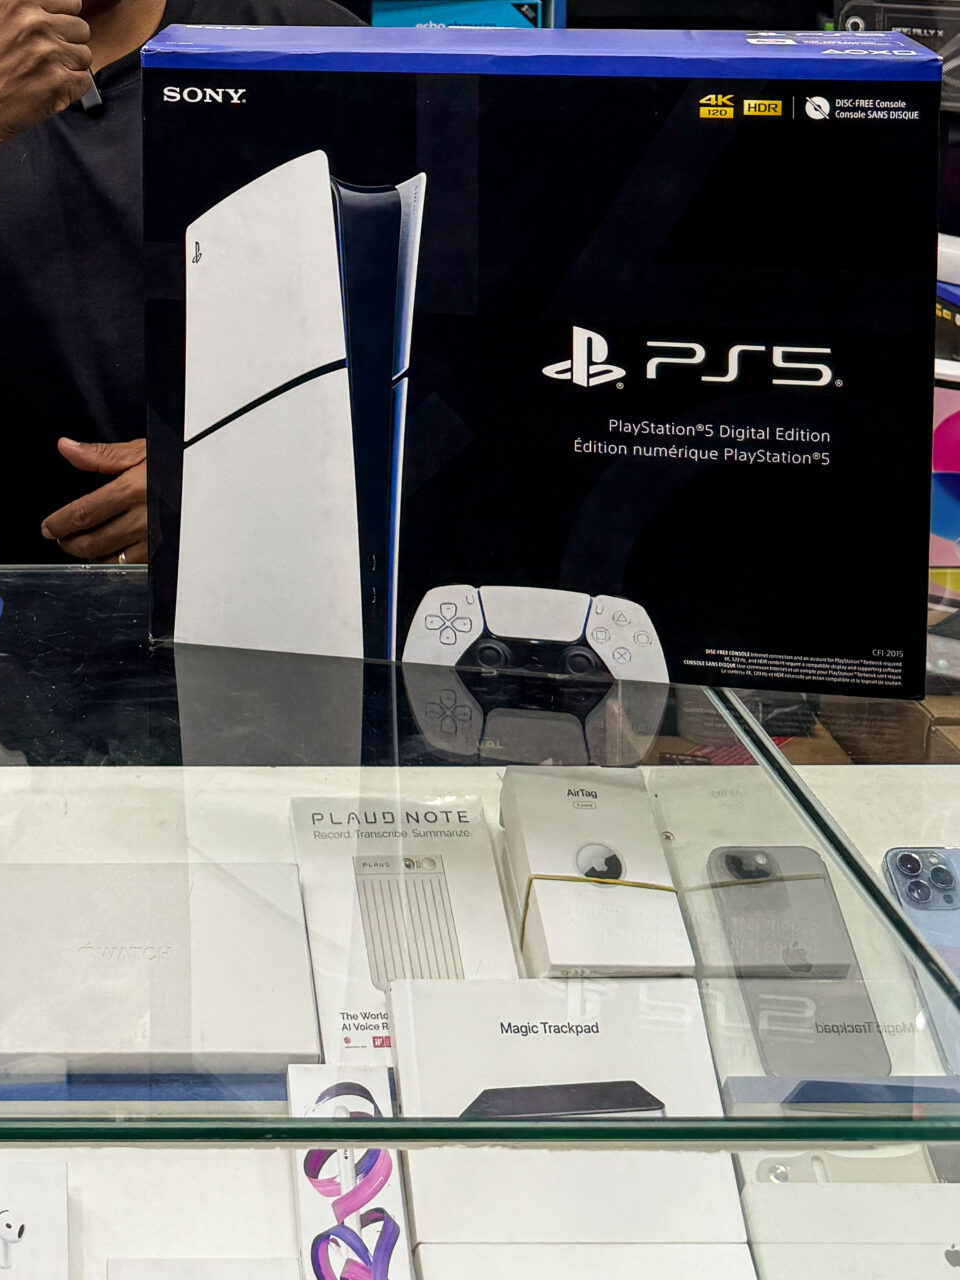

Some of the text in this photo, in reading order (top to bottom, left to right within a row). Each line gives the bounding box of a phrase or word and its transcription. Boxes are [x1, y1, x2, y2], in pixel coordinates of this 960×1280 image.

[163, 86, 246, 104] SONY
[698, 94, 735, 106] 4K
[747, 102, 779, 114] HDR
[835, 99, 906, 108] DISC-FREE Console
[707, 109, 728, 117] 120
[835, 110, 919, 120] Console SANS DISQUE
[646, 341, 832, 386] PS5
[719, 424, 770, 444] Digital
[774, 426, 831, 442] Edition
[574, 437, 628, 455] Édition
[632, 440, 719, 462] numérique
[872, 649, 904, 658] CFI-2015
[566, 788, 598, 799] AirTag
[312, 810, 470, 825] PLAUD NOTE
[313, 829, 472, 840] Record. Summarize.
[98, 944, 174, 962] WATCH
[340, 1011, 359, 1021] The
[341, 1022, 379, 1031] AI Voice
[500, 1022, 600, 1036] Magic Trackpad
